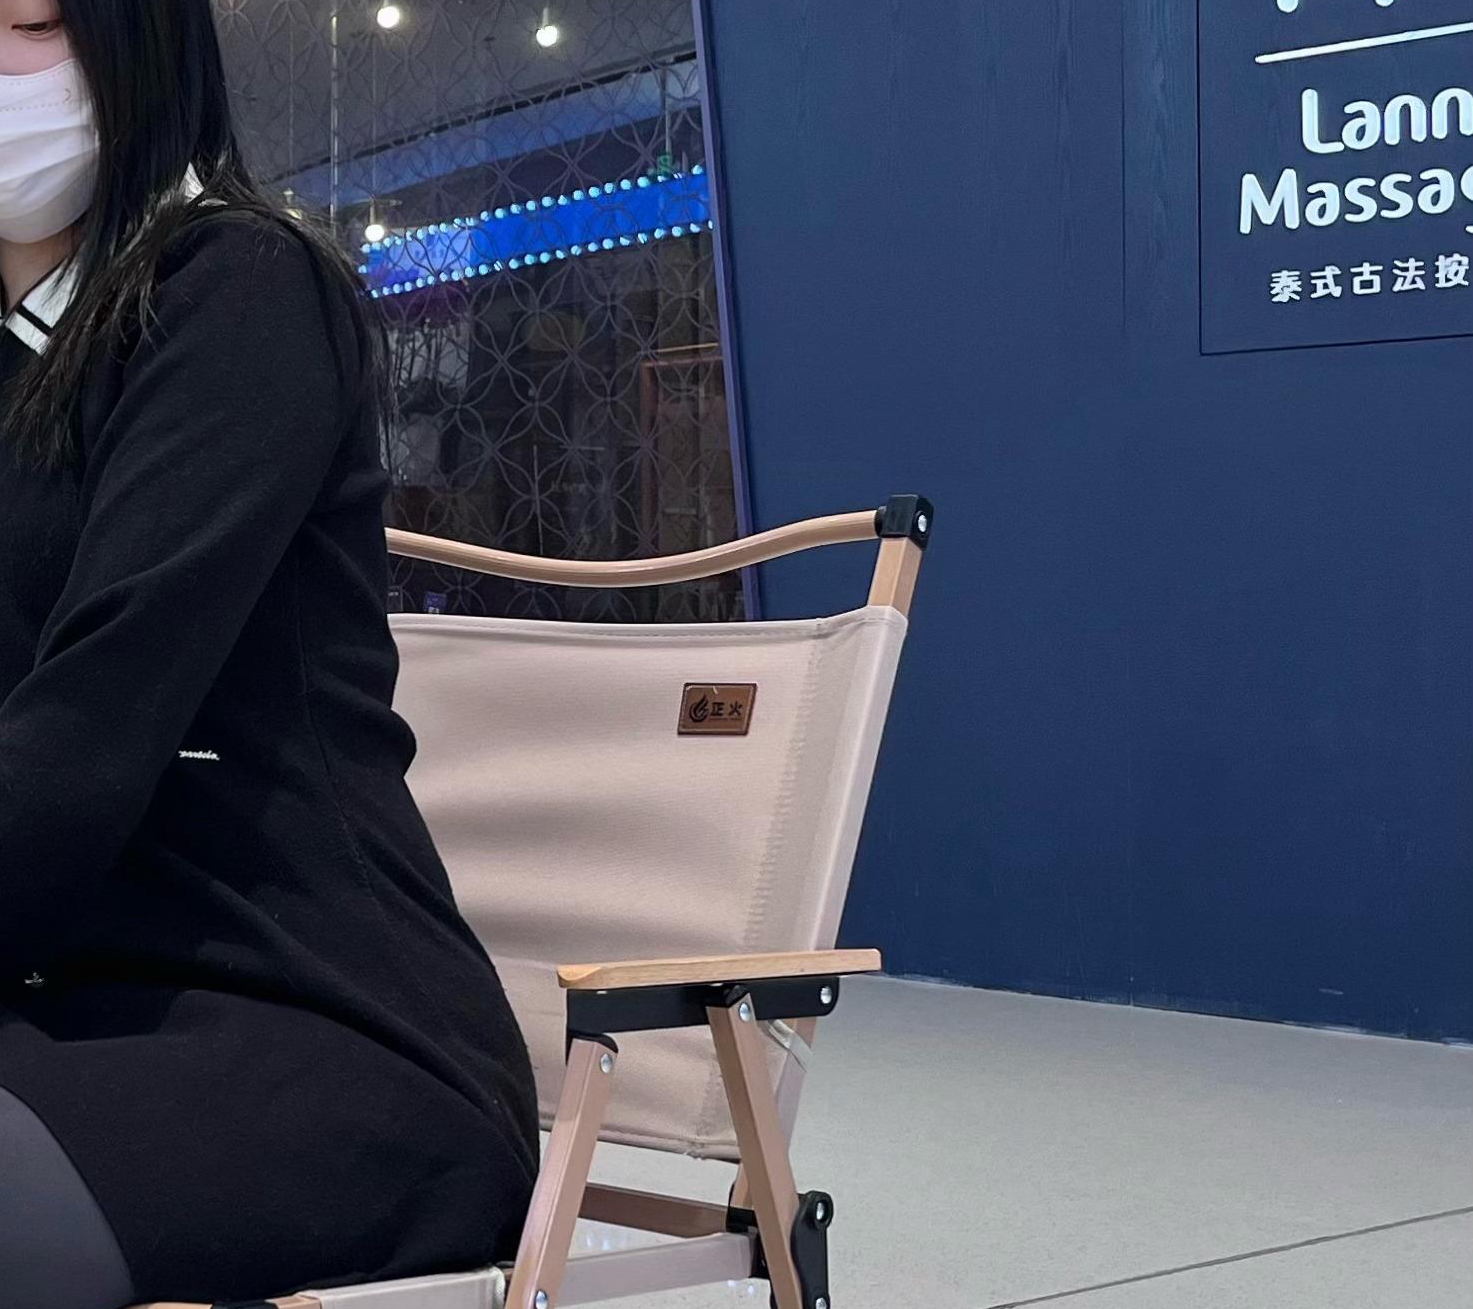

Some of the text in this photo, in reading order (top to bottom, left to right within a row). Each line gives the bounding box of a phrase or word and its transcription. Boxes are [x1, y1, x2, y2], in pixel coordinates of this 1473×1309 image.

[1301, 87, 1473, 154] Lann
[1269, 252, 1470, 303] 泰式古法按
